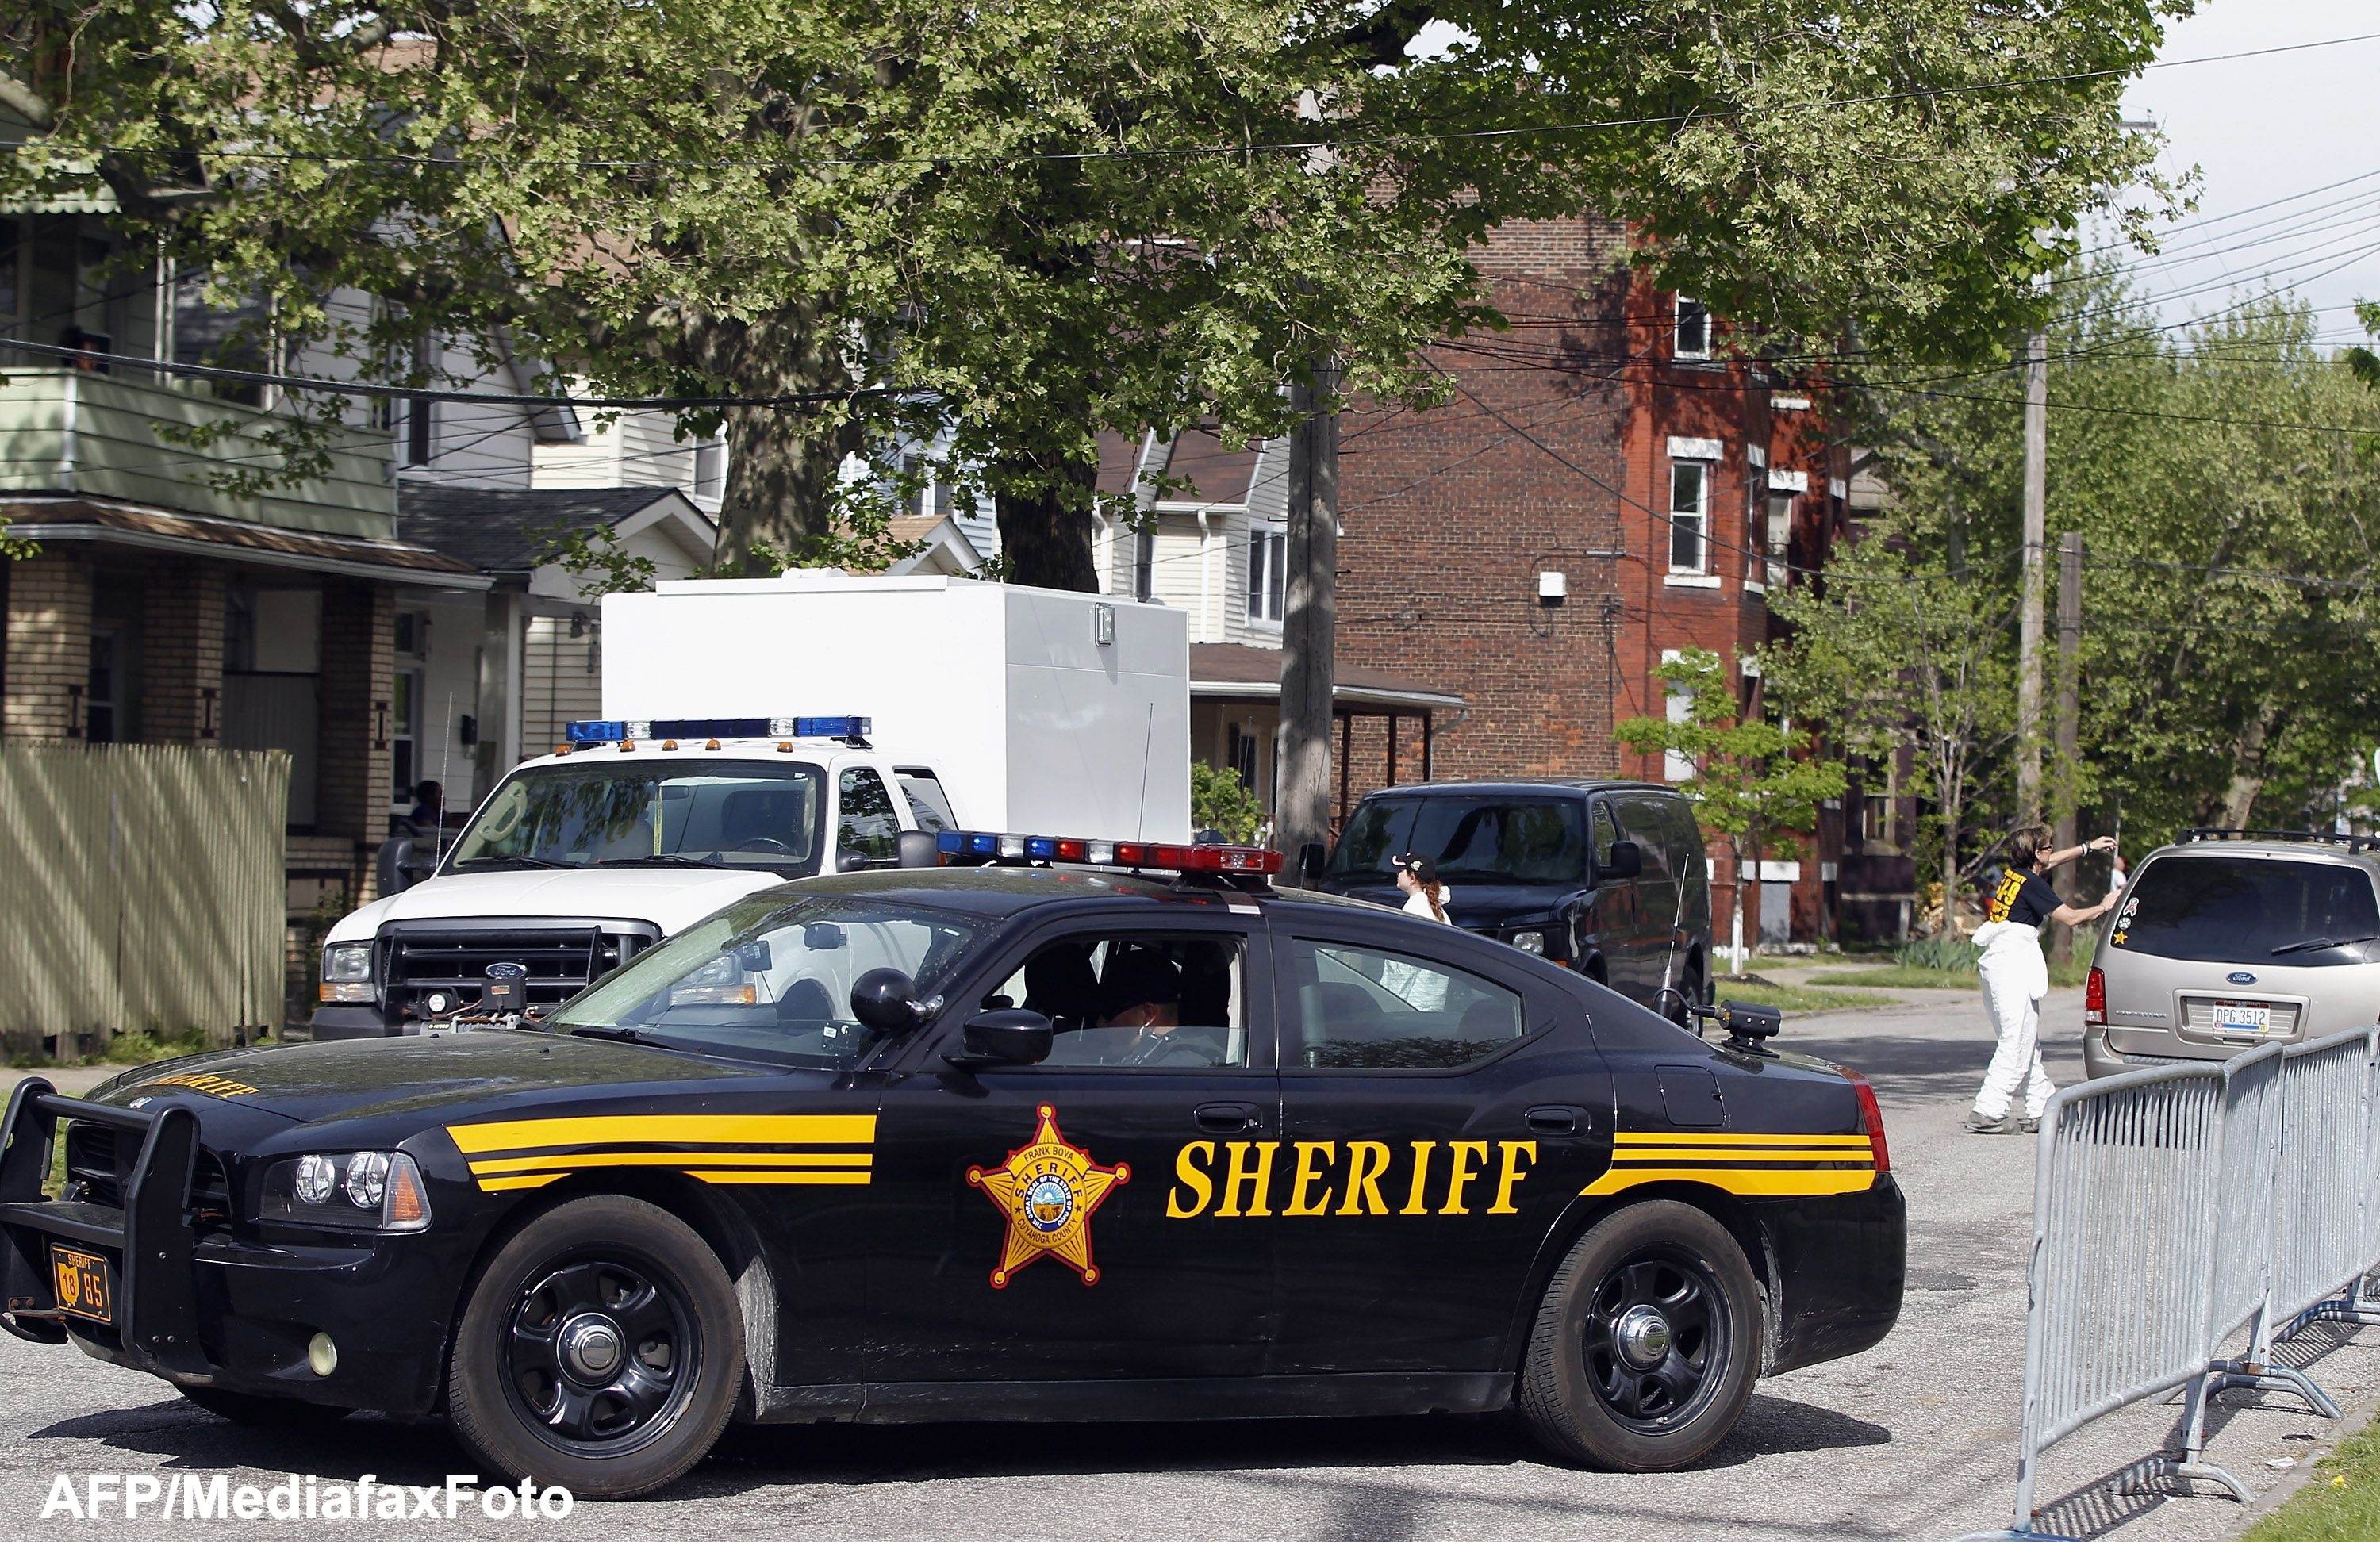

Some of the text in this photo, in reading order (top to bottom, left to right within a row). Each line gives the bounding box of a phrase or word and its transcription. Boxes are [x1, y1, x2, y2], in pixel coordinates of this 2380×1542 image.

[494, 965, 516, 976] Ford
[2217, 1008, 2266, 1025] DPG 3512
[1023, 1146, 1073, 1162] FRANK BOVA
[1015, 1162, 1083, 1199] SHERIFF
[1165, 1141, 1537, 1218] SHERIFF
[1059, 1180, 1072, 1200] STATE
[1031, 1218, 1042, 1229] THE
[1058, 1210, 1069, 1226] OHIO
[1017, 1218, 1077, 1244] CUYAHOGA COUNTY
[67, 1254, 91, 1269] SHERIFF
[63, 1272, 102, 1307] 18 85
